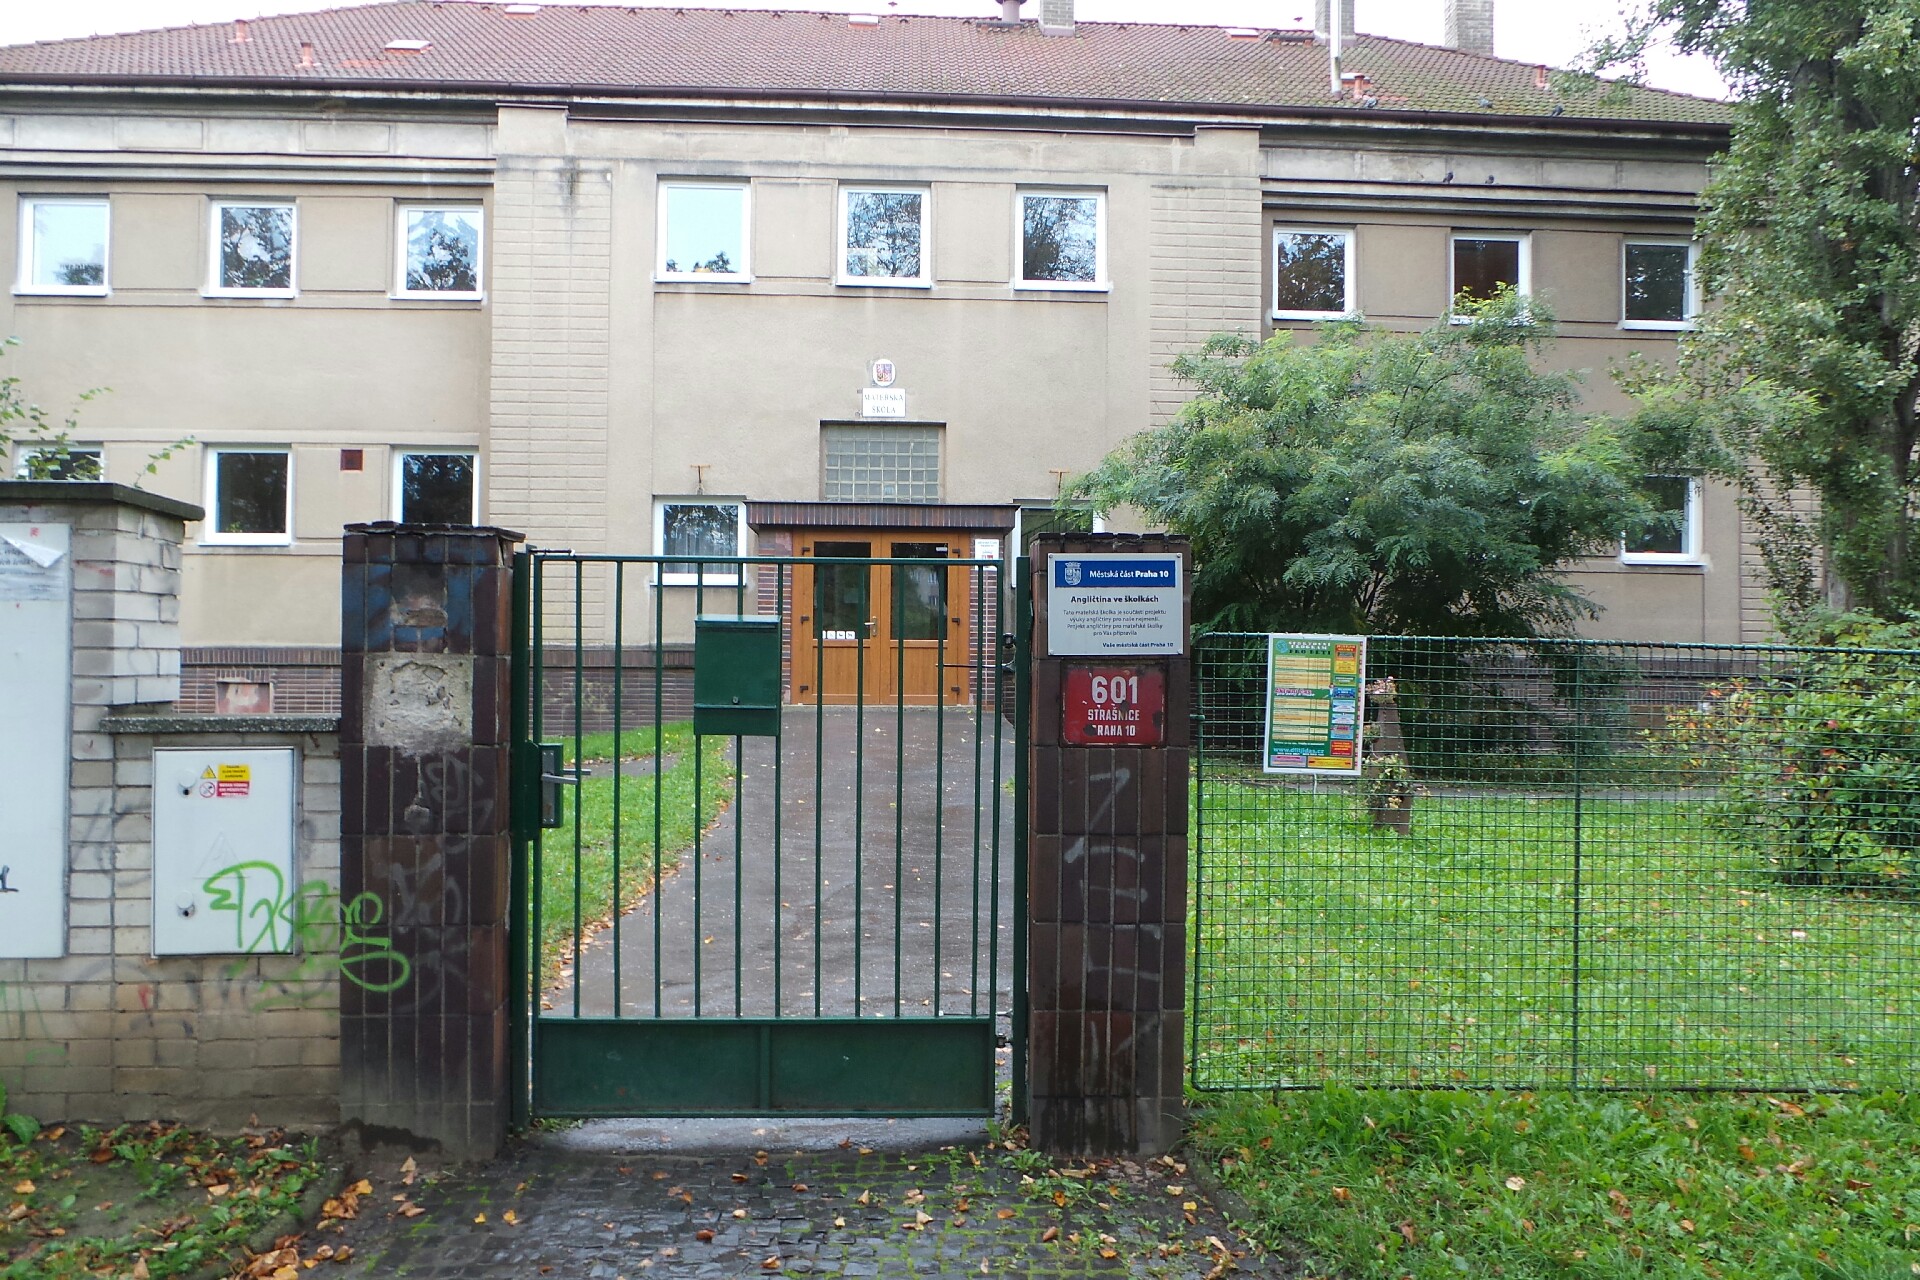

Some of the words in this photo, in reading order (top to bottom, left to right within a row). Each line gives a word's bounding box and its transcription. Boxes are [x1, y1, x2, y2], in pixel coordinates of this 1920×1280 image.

[1090, 570, 1119, 578] Městská
[1120, 570, 1134, 578] část
[1071, 596, 1111, 604] Angličtina
[1092, 676, 1138, 704] 601
[1092, 725, 1122, 736] RAHA
[1126, 725, 1136, 736] 10
